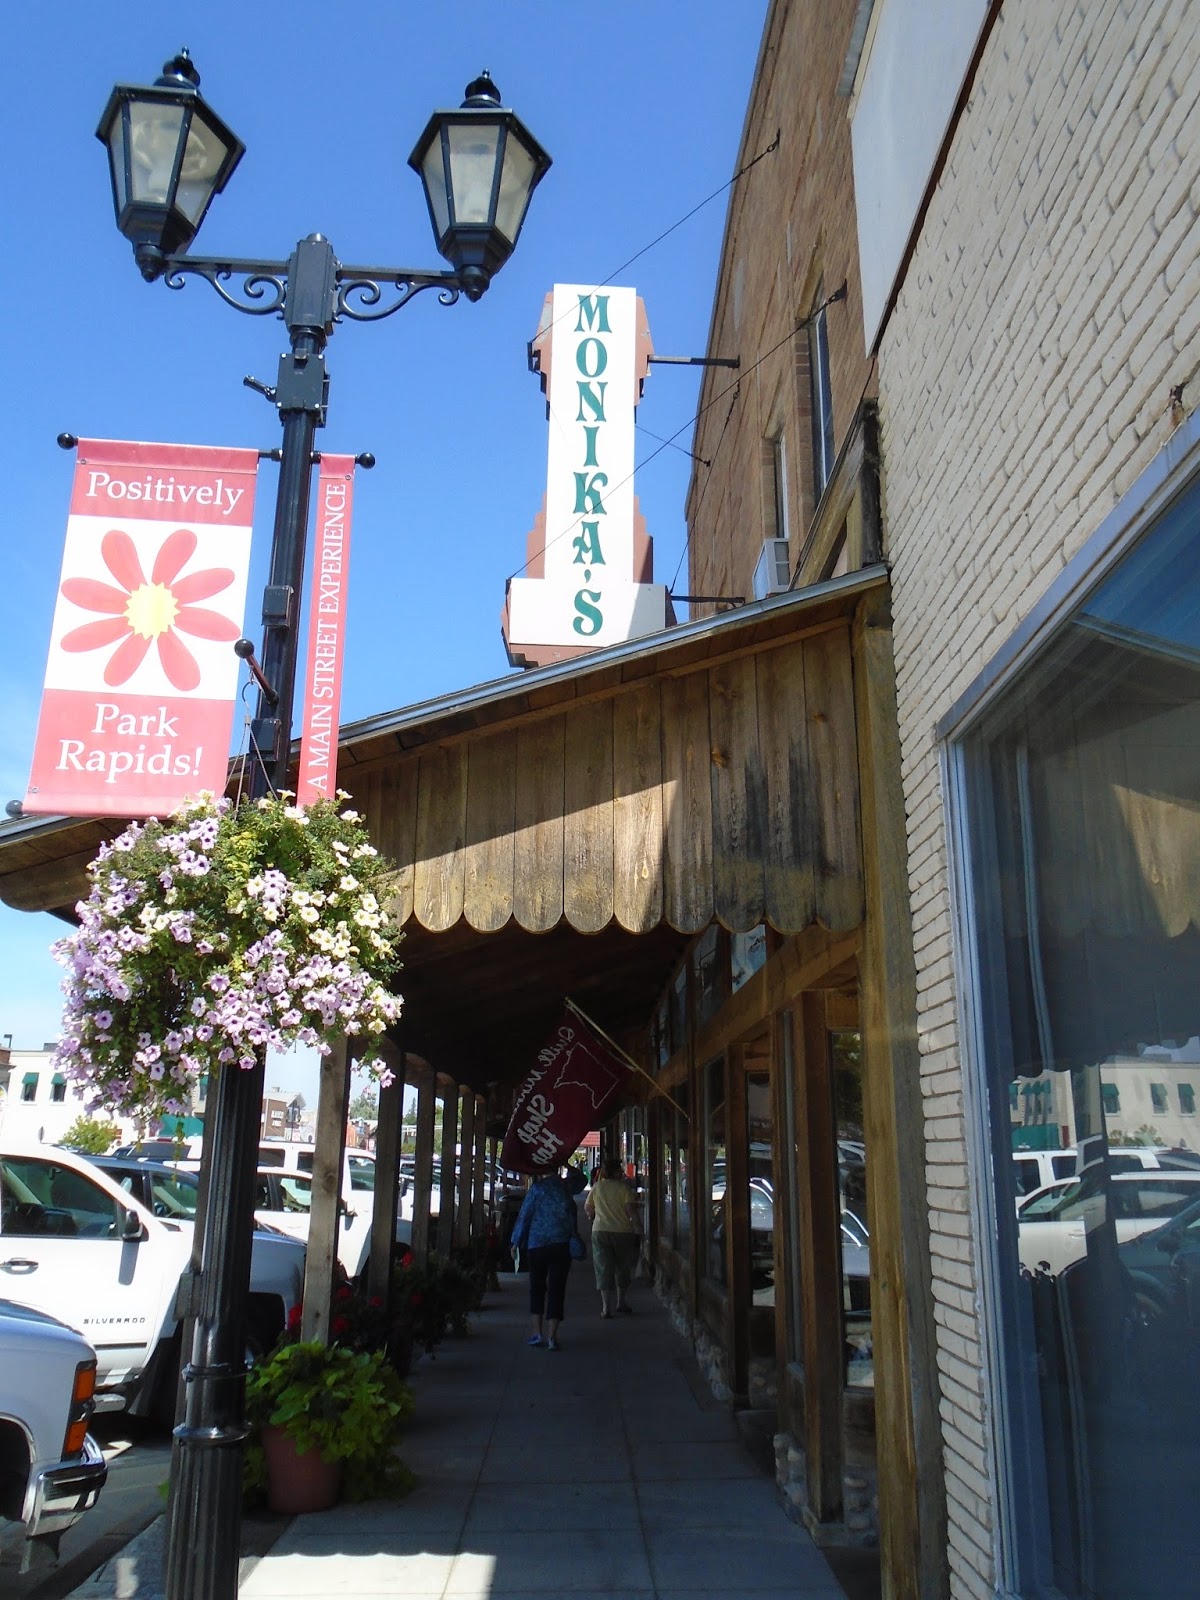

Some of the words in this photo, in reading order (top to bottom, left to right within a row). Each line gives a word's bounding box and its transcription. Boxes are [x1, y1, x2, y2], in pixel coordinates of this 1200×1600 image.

[573, 294, 613, 637] MONIKA'S
[86, 471, 245, 515] Positively
[320, 483, 347, 615] EXPERIENCE
[313, 620, 338, 698] STREET
[91, 703, 179, 738] Park
[309, 703, 332, 769] MAIN
[55, 739, 203, 784] Rapids!
[307, 774, 328, 791] A
[83, 1317, 146, 1325] SILVERADO
